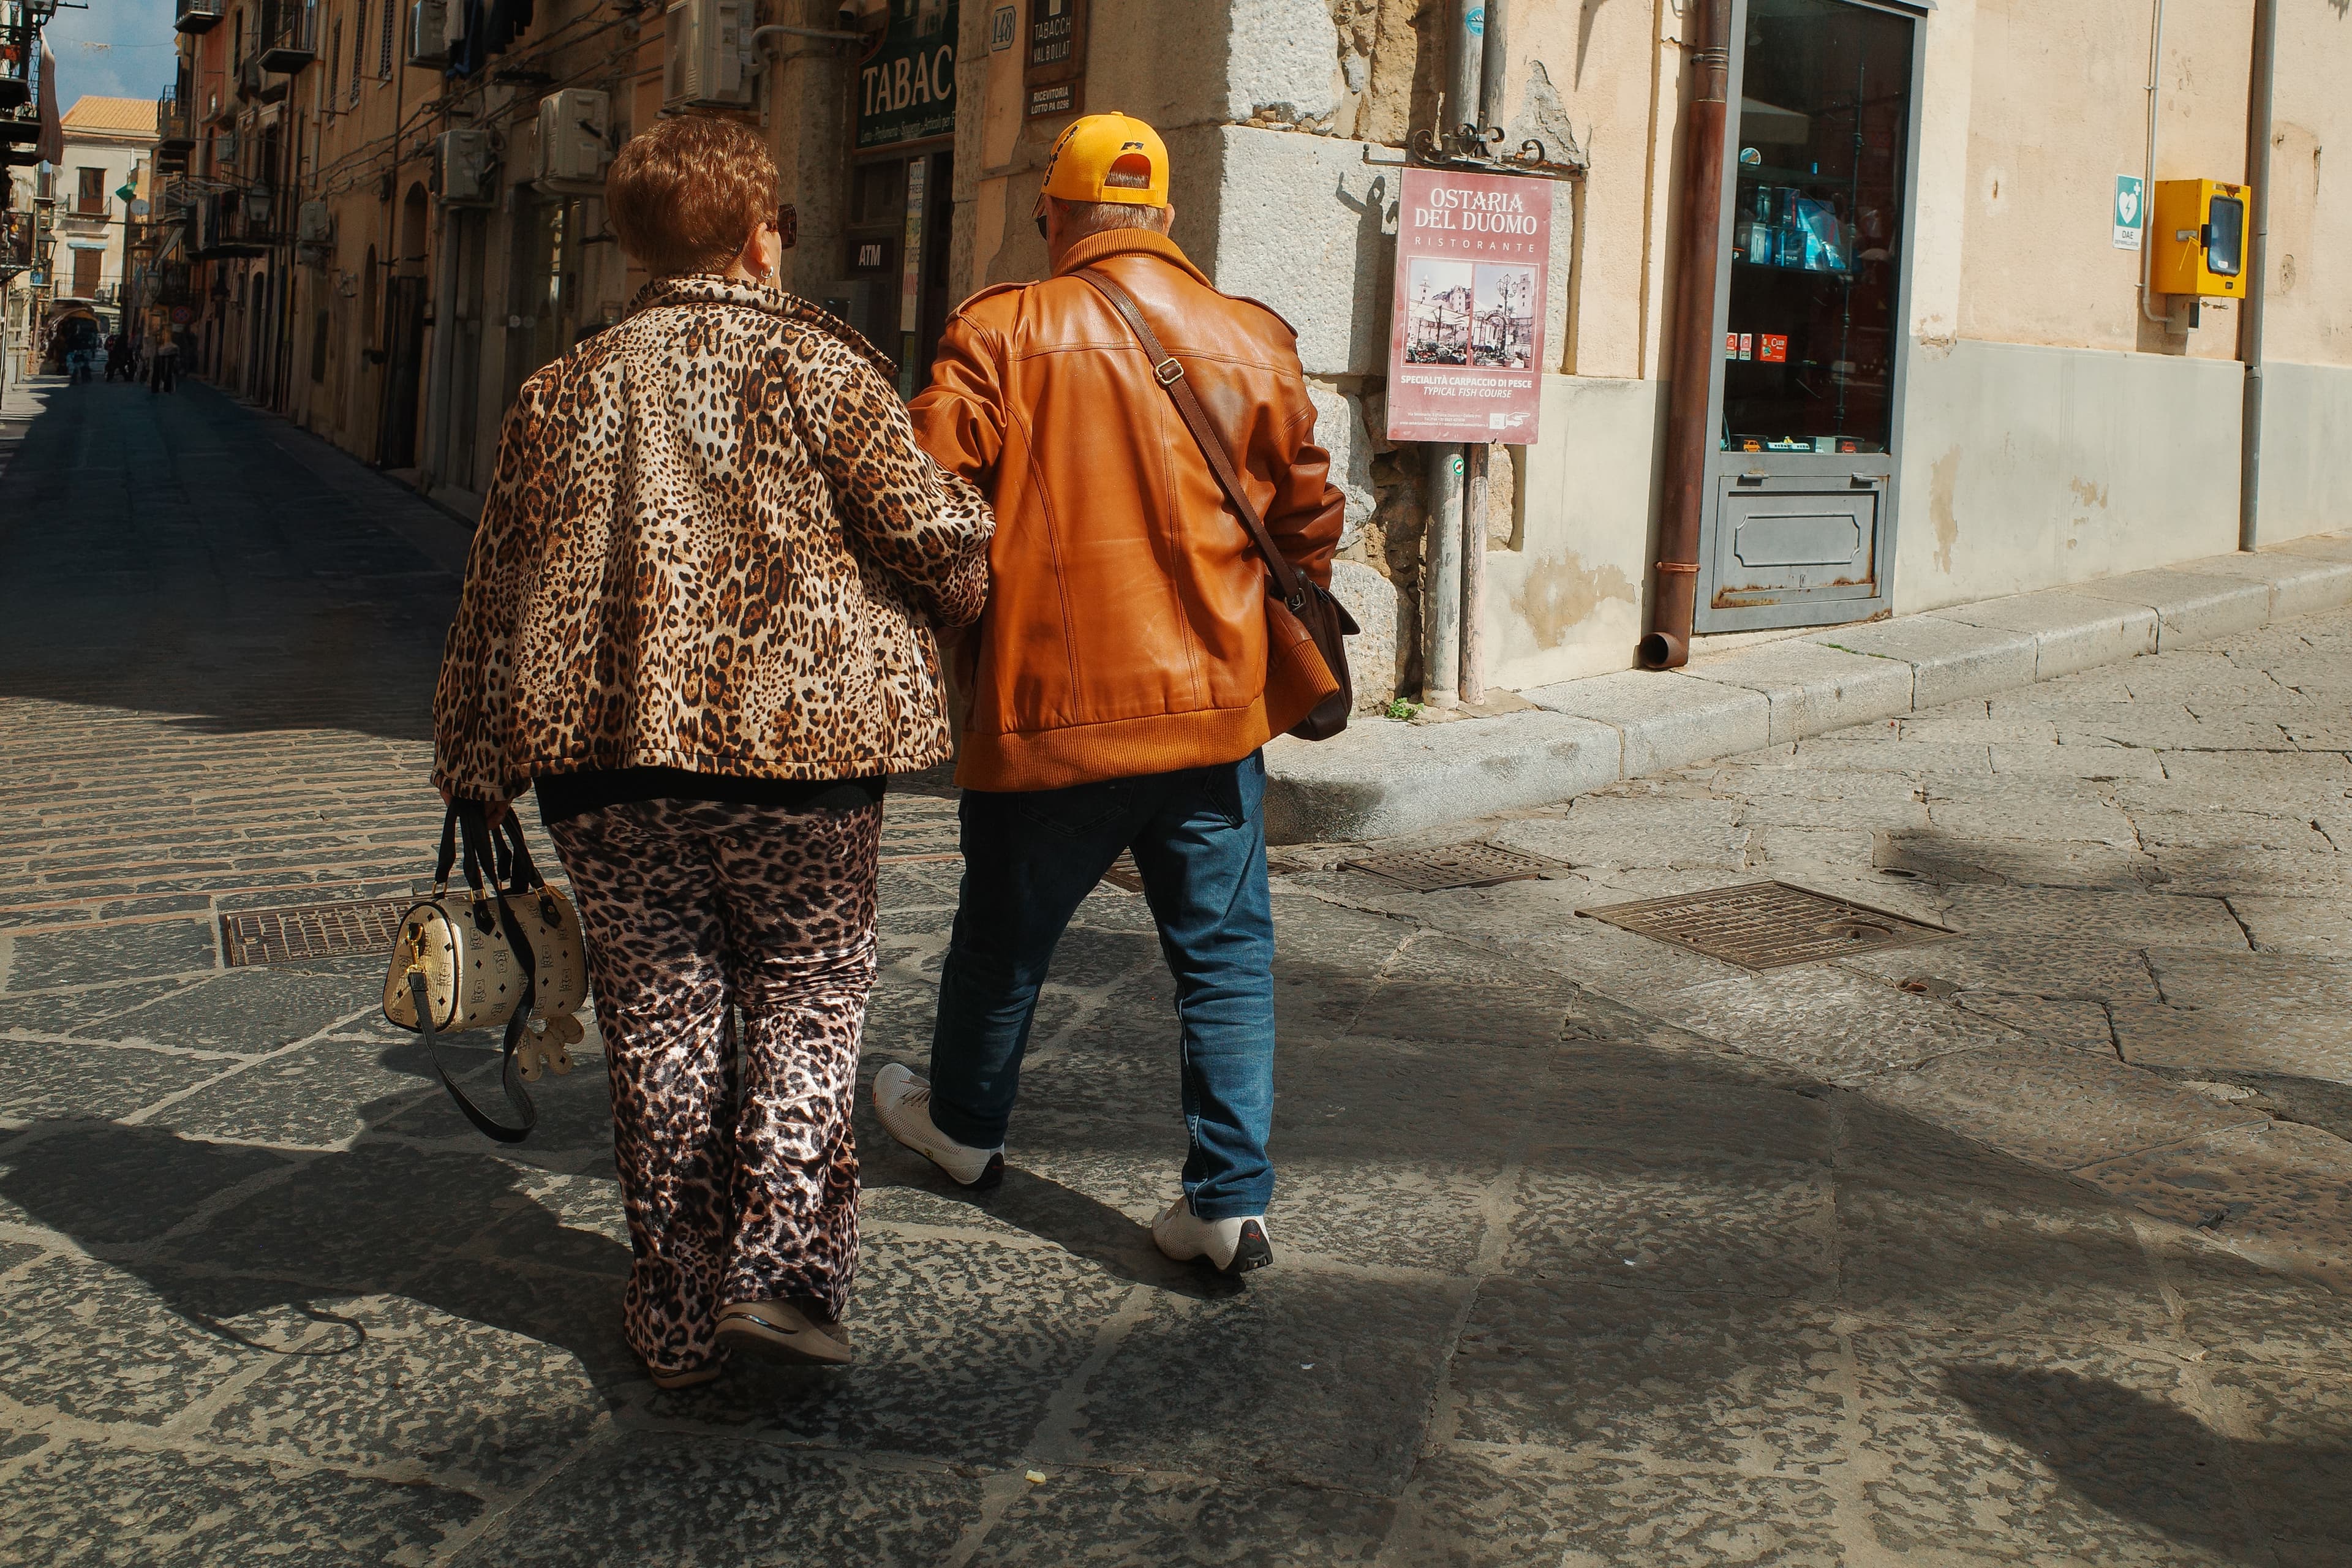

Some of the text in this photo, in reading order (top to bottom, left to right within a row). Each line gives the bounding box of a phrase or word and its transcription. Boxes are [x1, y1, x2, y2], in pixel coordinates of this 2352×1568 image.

[992, 11, 1014, 44] 148
[1035, 16, 1071, 40] TABACCH
[862, 45, 952, 116] TABAC
[1033, 86, 1069, 102] RICEVITORIA
[1031, 104, 1049, 115] LOTTO
[1049, 102, 1056, 111] PA
[1430, 188, 1524, 213] OSTARIA
[1415, 208, 1537, 235] DEL DUOMO
[1415, 236, 1535, 252] RISTORANTE
[2122, 230, 2134, 239] DAE
[858, 244, 881, 266] ATM
[1401, 374, 1447, 385] SPECIALITÀ
[1449, 377, 1496, 387] CARPACCIO
[1508, 379, 1532, 388] PESCE
[1423, 386, 1456, 396] TYPICAL
[1479, 389, 1512, 398] COURSE
